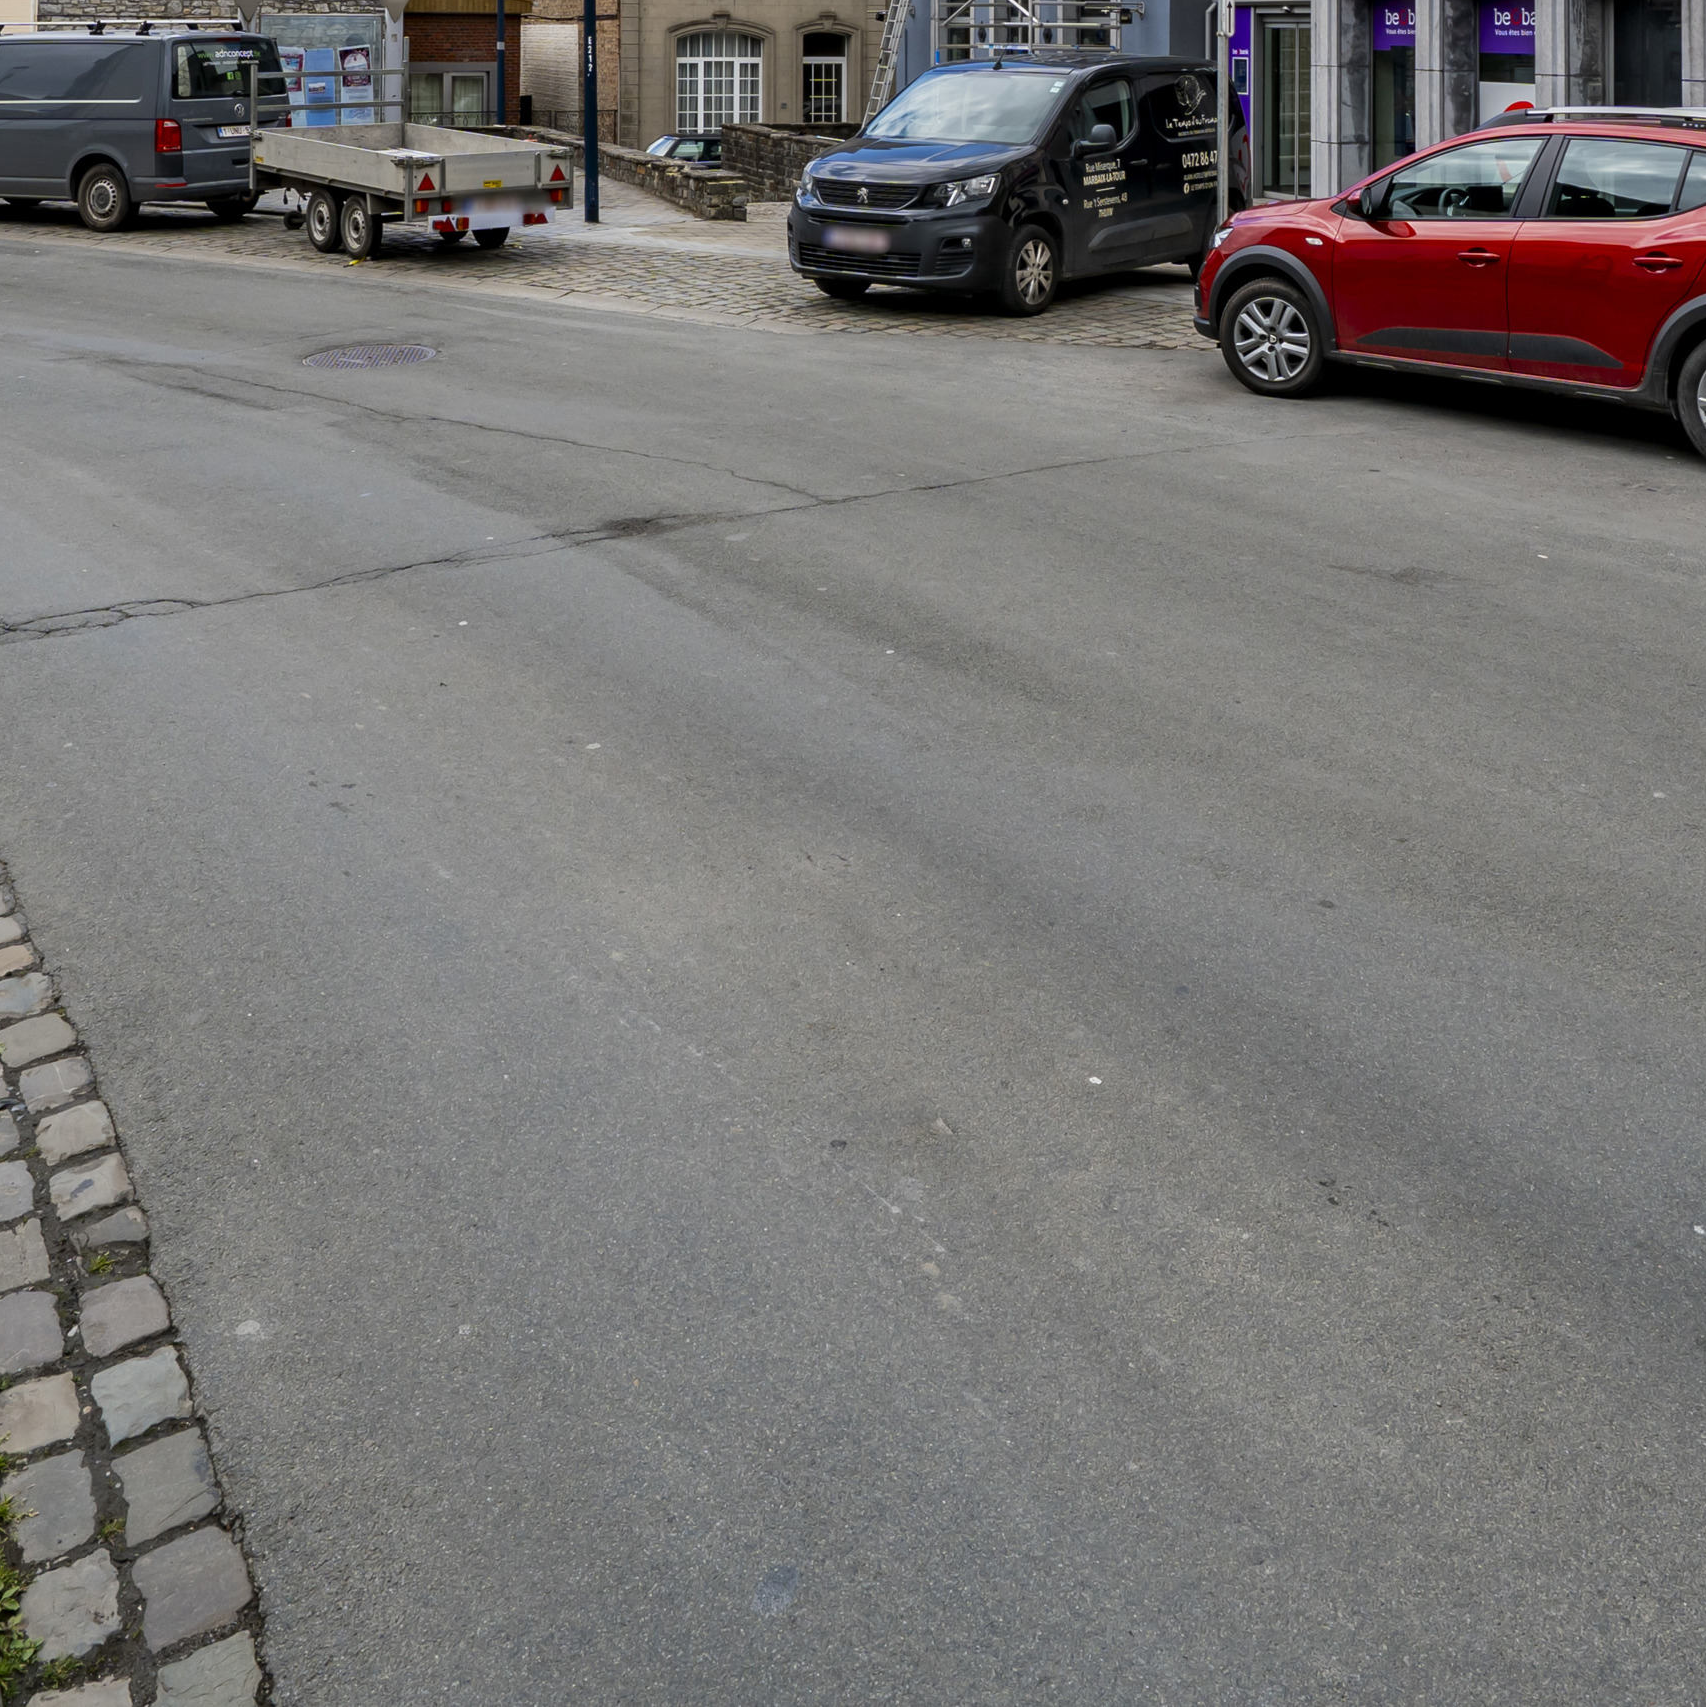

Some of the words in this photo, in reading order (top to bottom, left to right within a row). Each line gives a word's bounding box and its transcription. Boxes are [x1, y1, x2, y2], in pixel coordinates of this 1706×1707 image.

[1508, 28, 1520, 36] êtes
[1182, 153, 1199, 168] 0472
[1200, 151, 1209, 166] 86
[1210, 150, 1218, 164] 47
